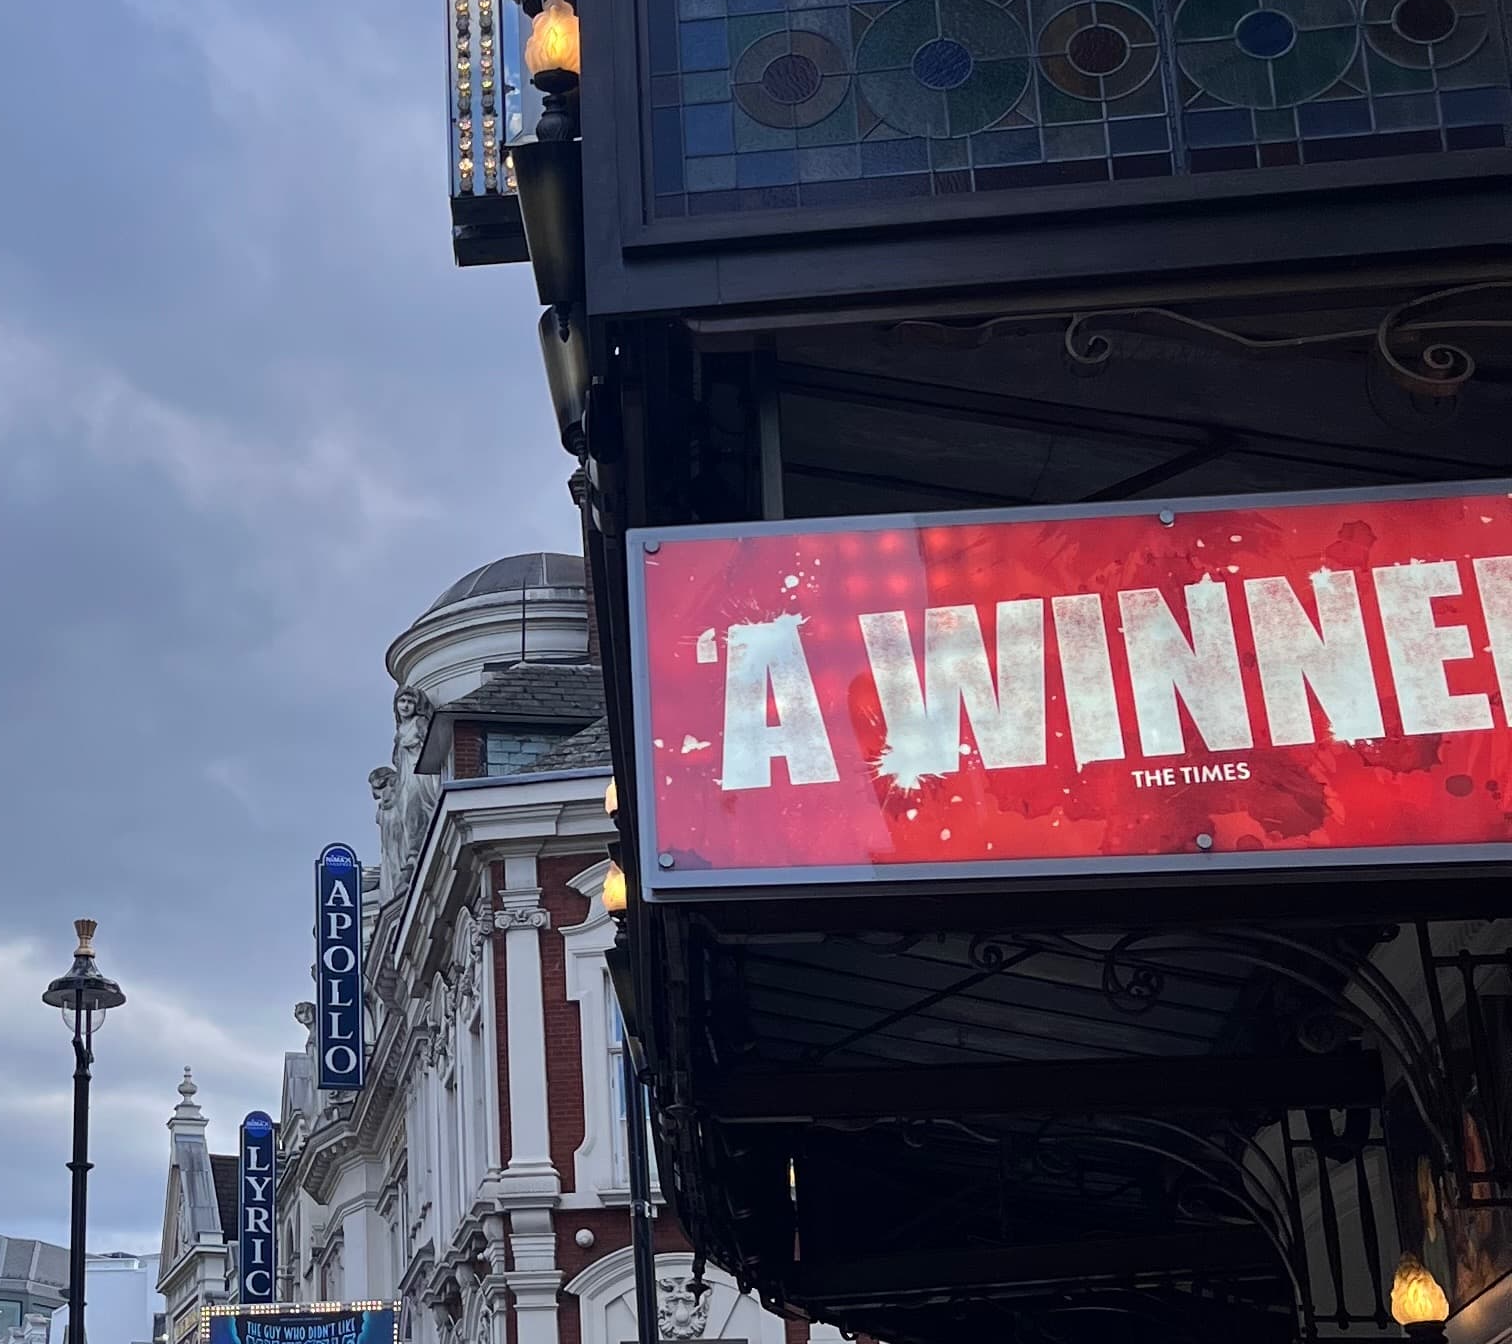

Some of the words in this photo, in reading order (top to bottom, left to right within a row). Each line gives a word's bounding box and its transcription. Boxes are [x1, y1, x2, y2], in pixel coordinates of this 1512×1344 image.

[1131, 769, 1176, 788] THE
[1179, 762, 1251, 785] TIMES
[323, 880, 358, 1074] APOLLO
[245, 1146, 272, 1296] LYRIC
[247, 1321, 261, 1338] THE
[264, 1324, 282, 1339] GUY
[284, 1325, 306, 1341] WHO
[308, 1321, 336, 1339] DIDN'T
[338, 1317, 355, 1335] LIKE
